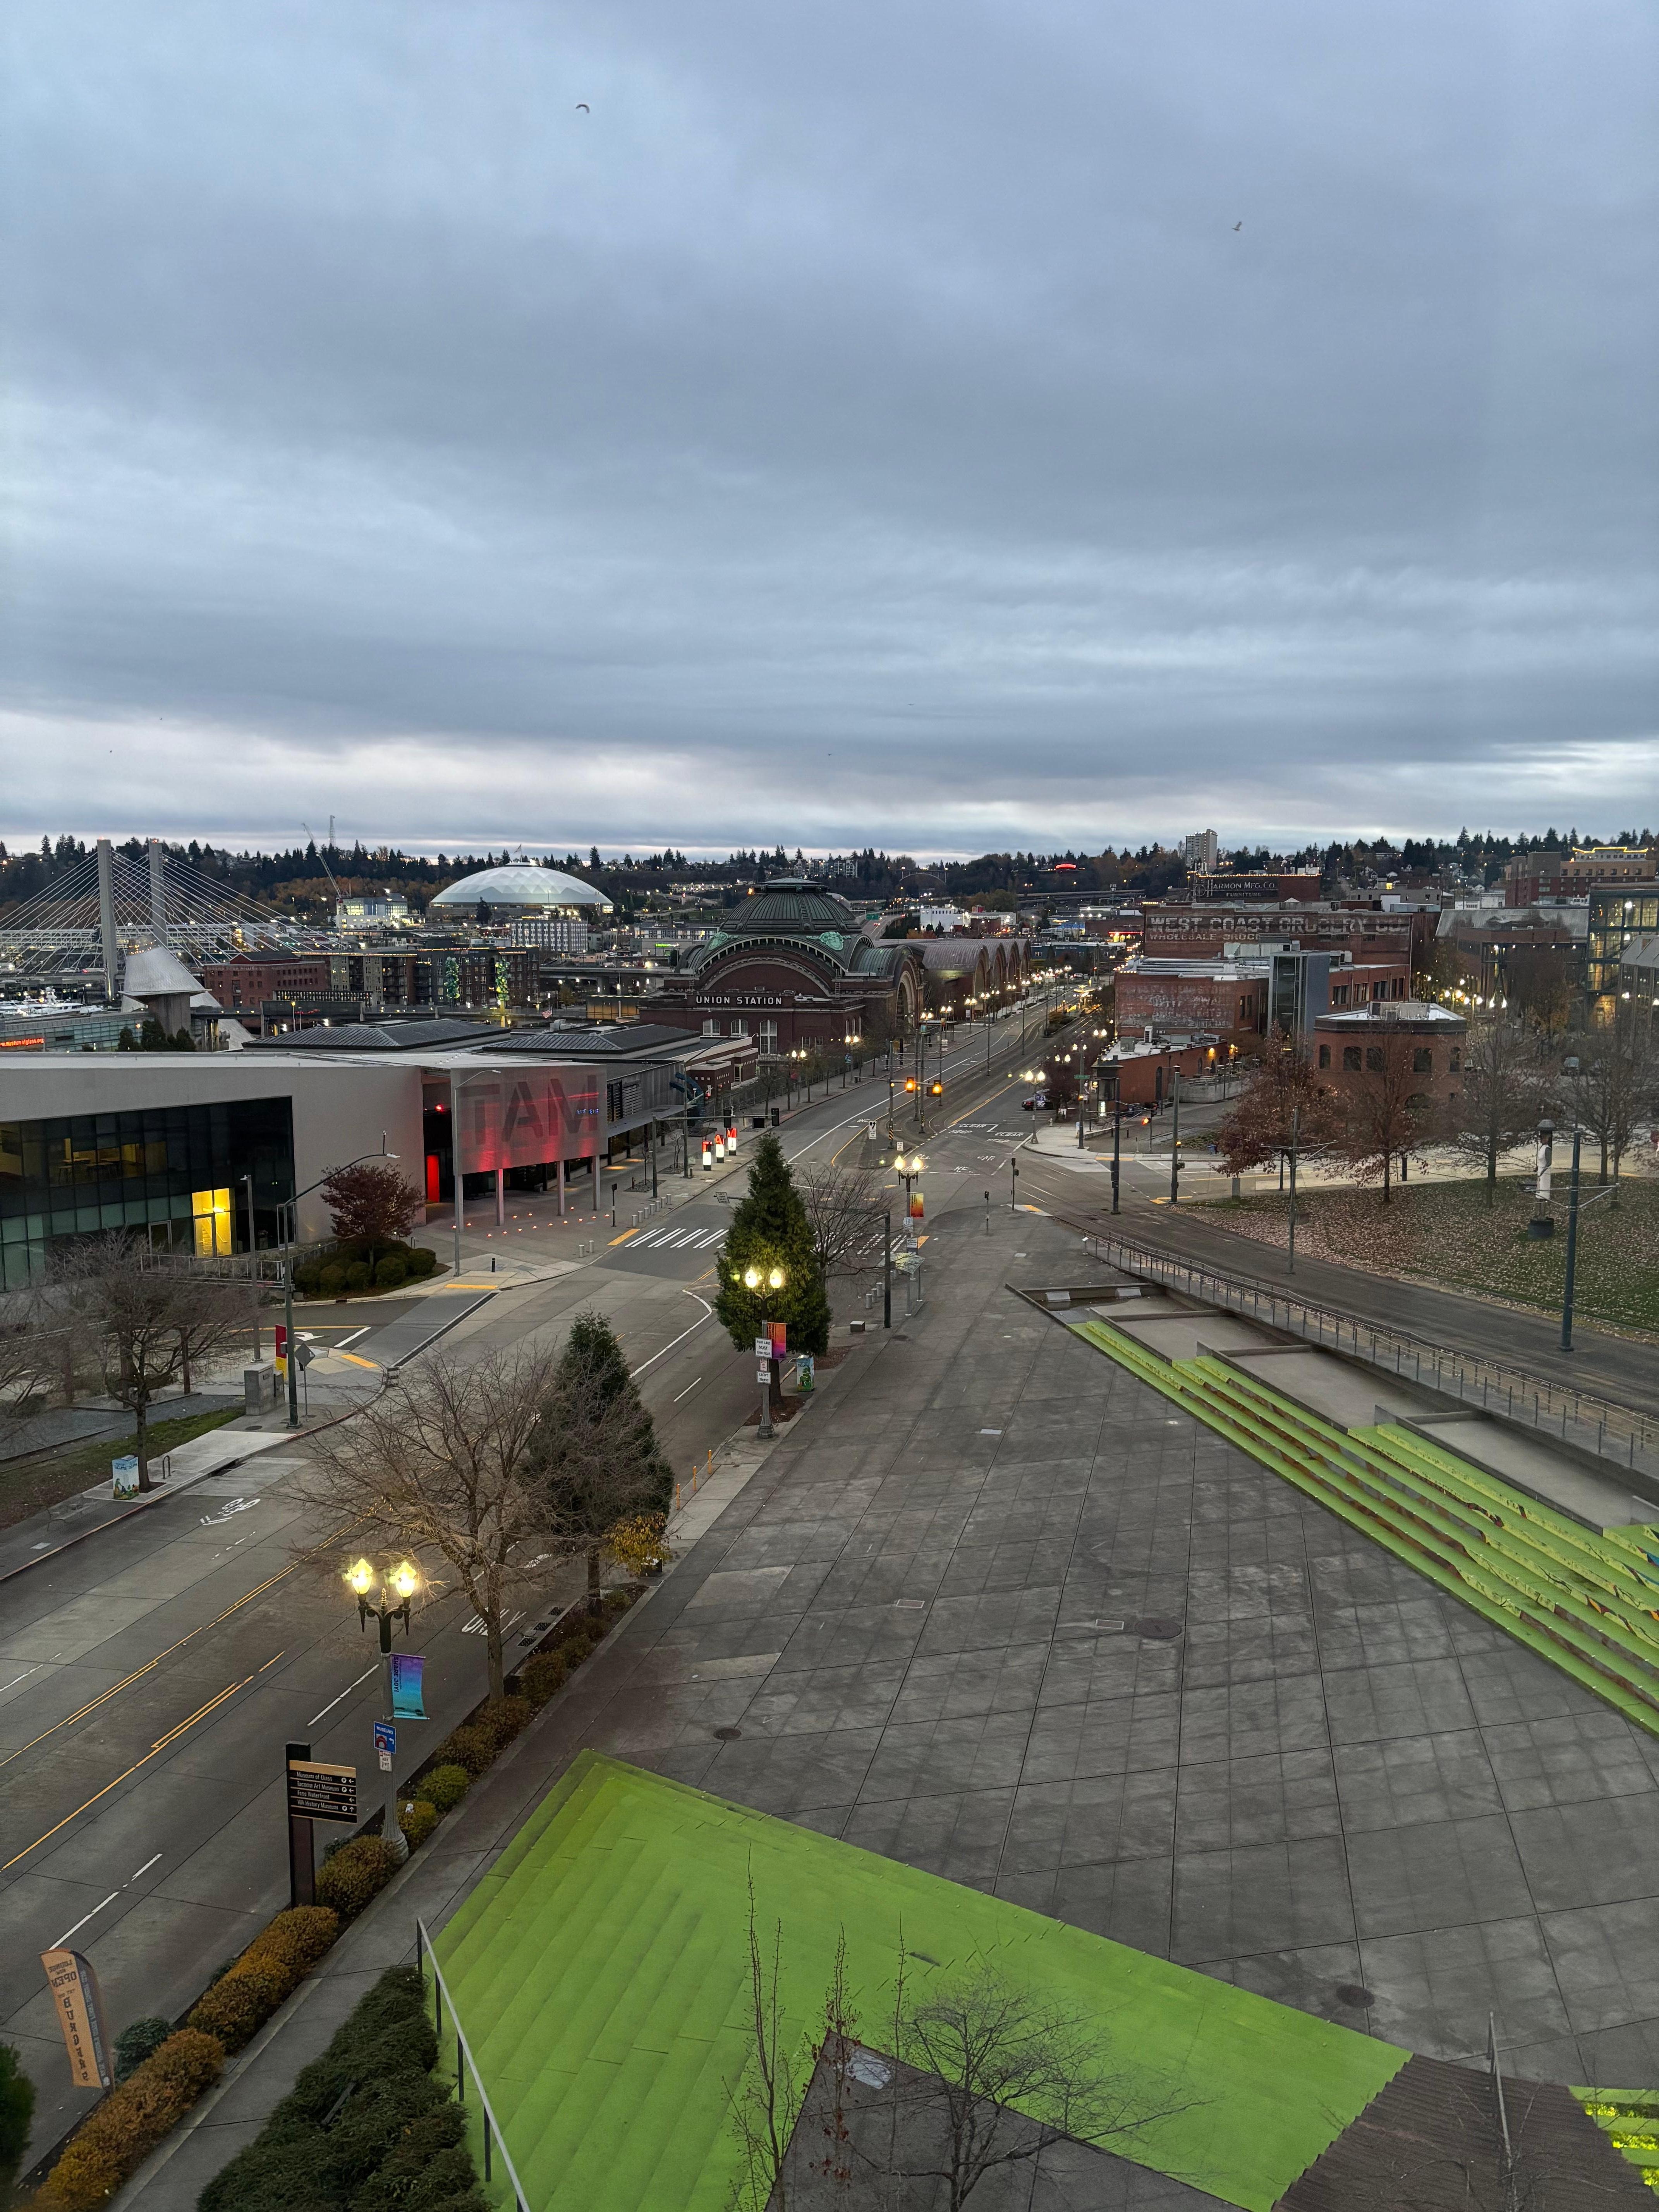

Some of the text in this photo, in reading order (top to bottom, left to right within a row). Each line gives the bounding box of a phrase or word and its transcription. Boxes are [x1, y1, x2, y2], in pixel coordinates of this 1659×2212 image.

[1151, 917, 1202, 933] WEST
[1210, 917, 1274, 933] COAST
[696, 996, 781, 1005] UNION STATION
[460, 1075, 599, 1146] TAM
[308, 1791, 330, 1800] Waterfront
